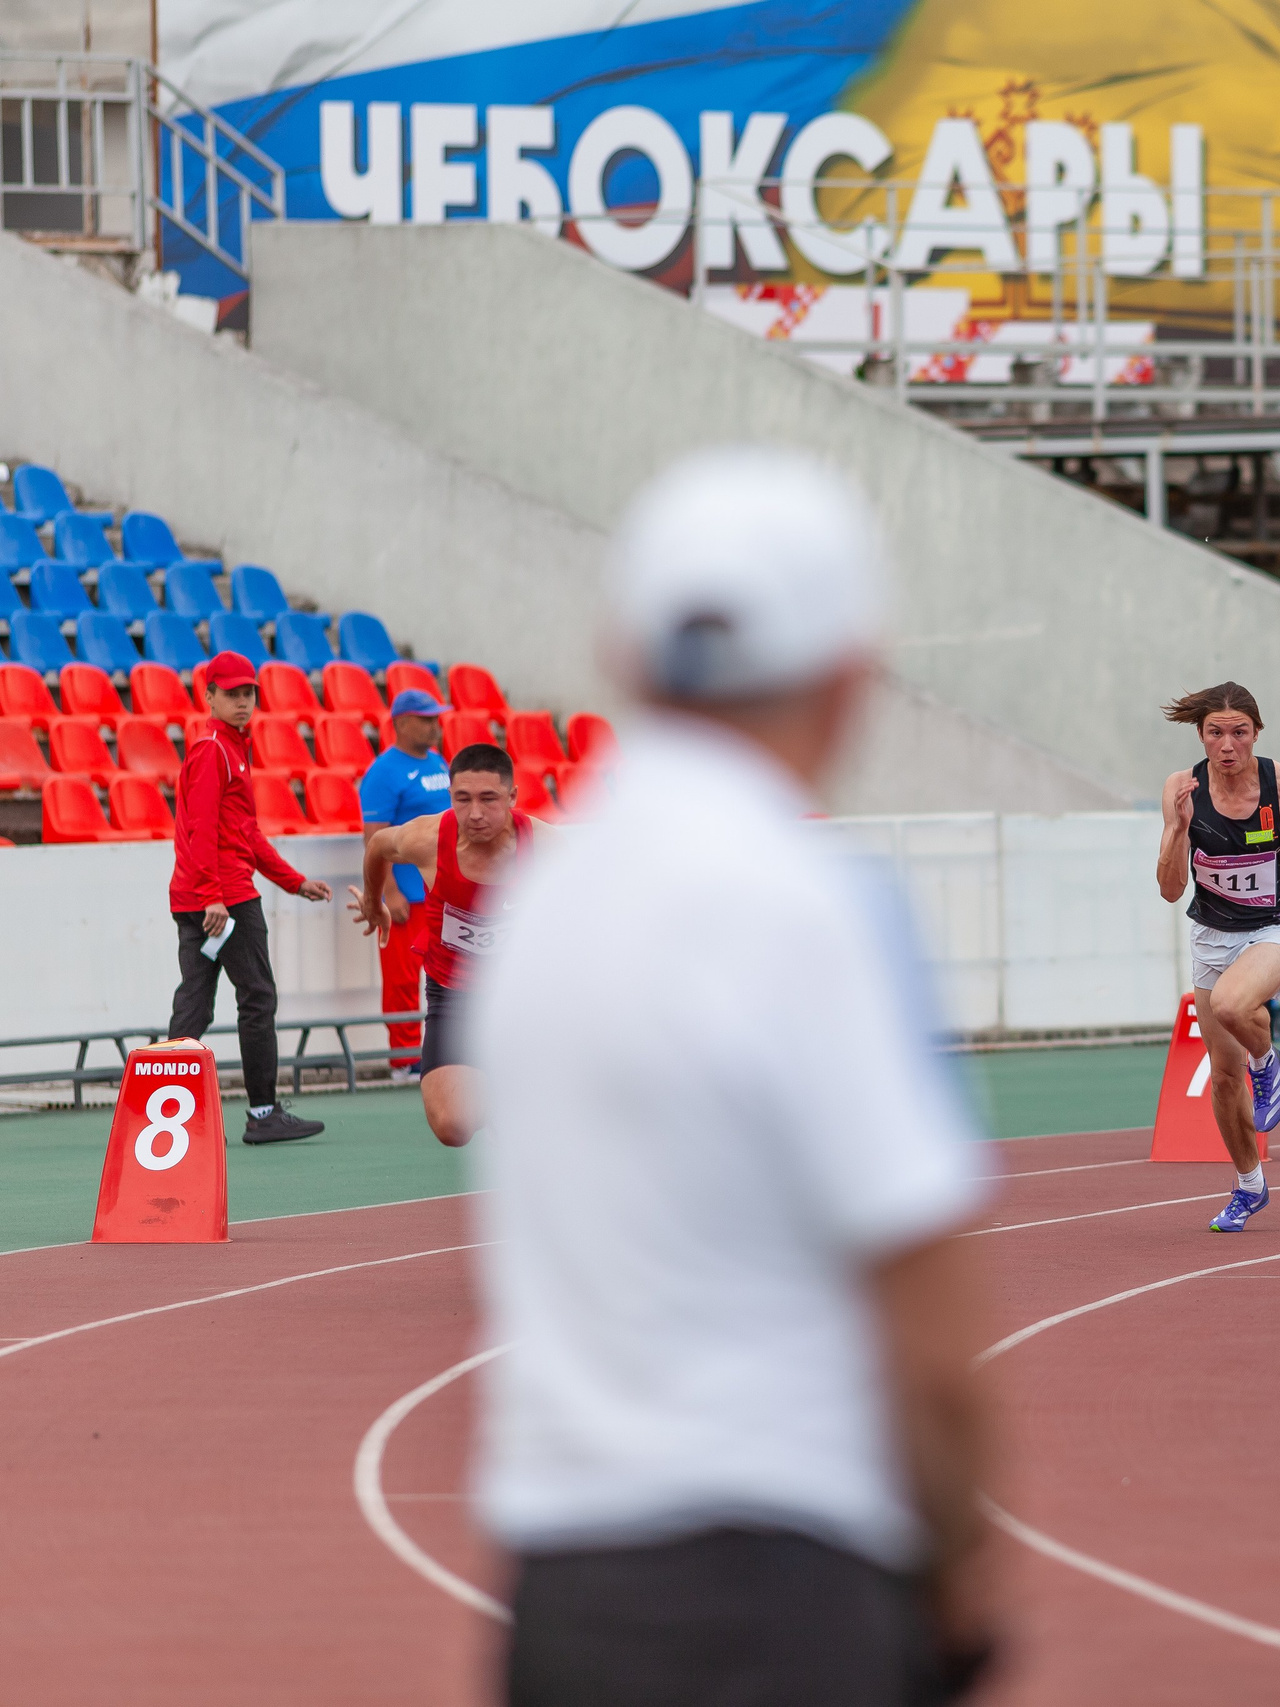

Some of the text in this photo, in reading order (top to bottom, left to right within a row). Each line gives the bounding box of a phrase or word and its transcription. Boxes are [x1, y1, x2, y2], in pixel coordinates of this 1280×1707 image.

[320, 101, 1205, 278] ЧЕБОКСАРЫ
[1209, 873, 1259, 891] 111
[135, 1062, 201, 1076] MONDO
[134, 1084, 196, 1171] 8
